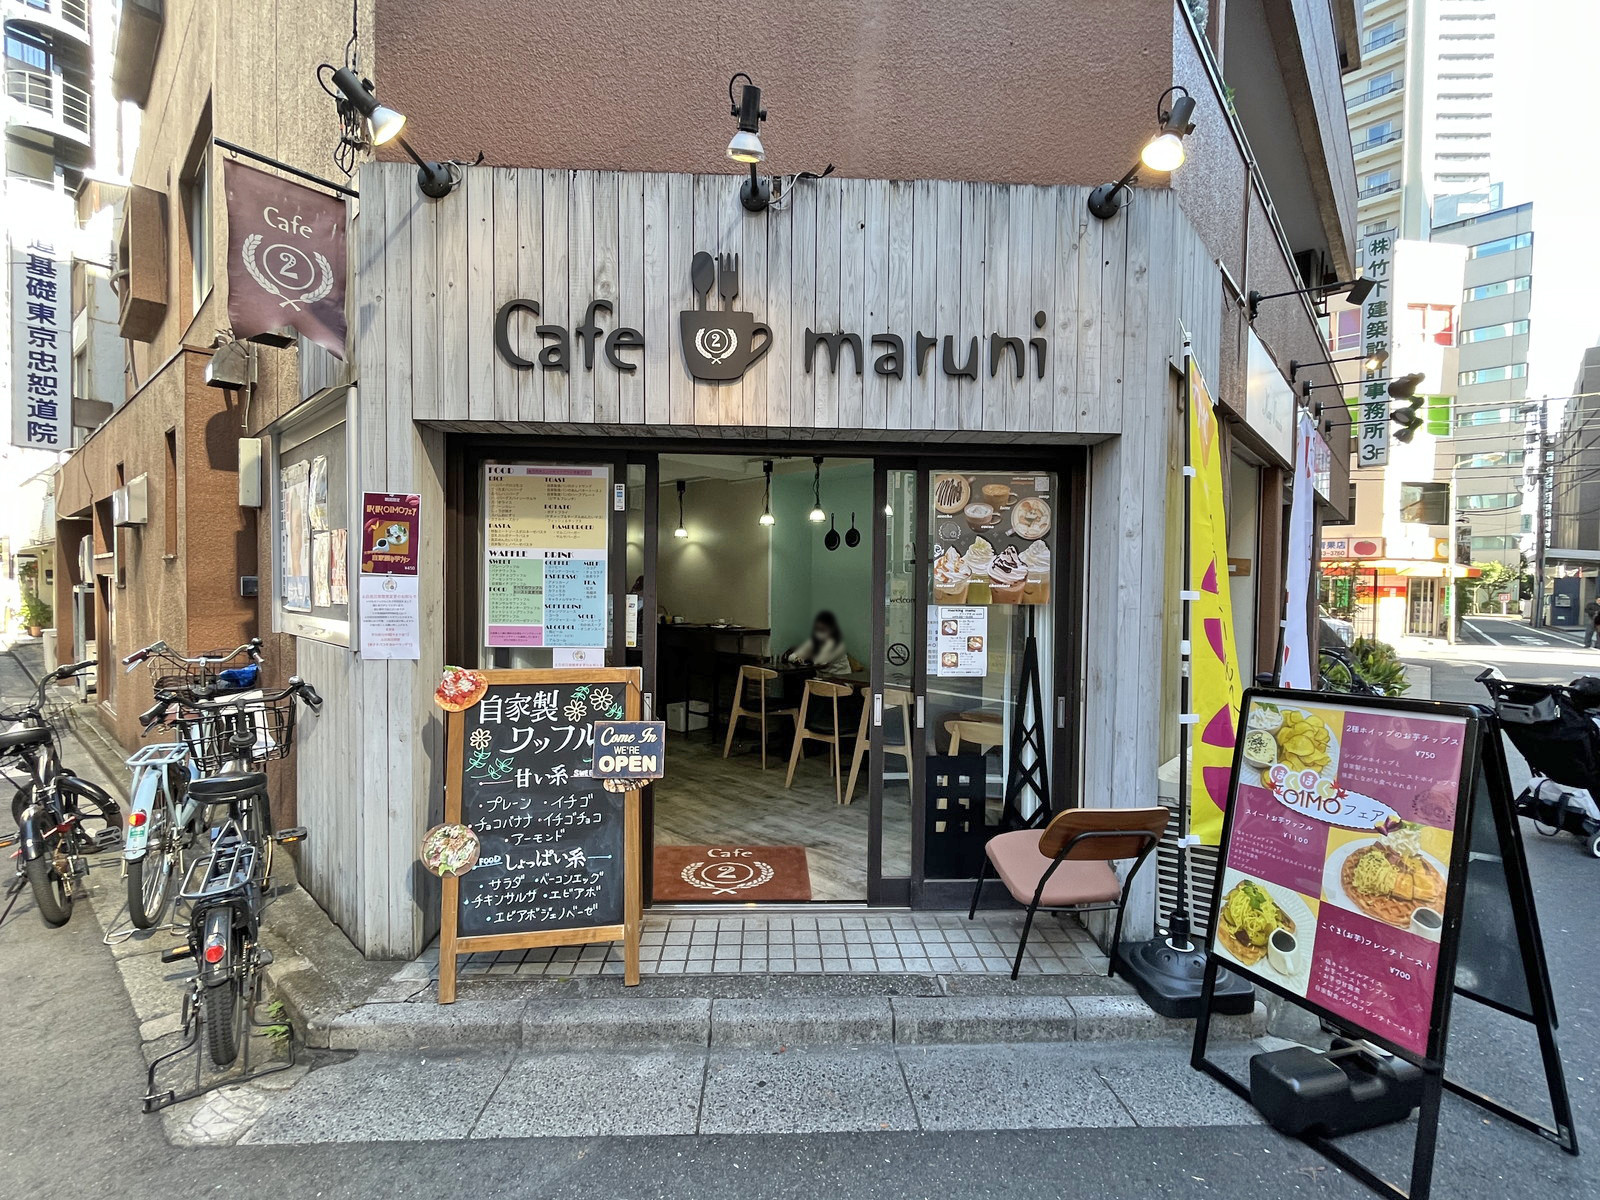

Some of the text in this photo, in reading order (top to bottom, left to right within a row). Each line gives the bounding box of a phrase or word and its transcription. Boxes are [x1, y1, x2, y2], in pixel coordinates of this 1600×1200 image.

[263, 206, 313, 239] Cafe
[279, 252, 299, 280] 2
[496, 298, 1048, 382] Cafe maruni
[710, 333, 722, 356] 2
[478, 690, 560, 724] 自家製
[500, 723, 595, 754] ワッフル
[600, 727, 658, 745] Come In
[613, 745, 640, 755] WE'RE
[1415, 750, 1436, 760] ¥750
[599, 755, 657, 773] OPEN
[513, 764, 568, 788] 甘い系
[1345, 805, 1385, 822] フェア
[1283, 832, 1310, 845] ¥1100
[479, 846, 587, 871] FOOD しょっぱい系
[707, 848, 753, 859] Cafe
[716, 865, 737, 879] 2
[1389, 966, 1412, 981] ¥700
